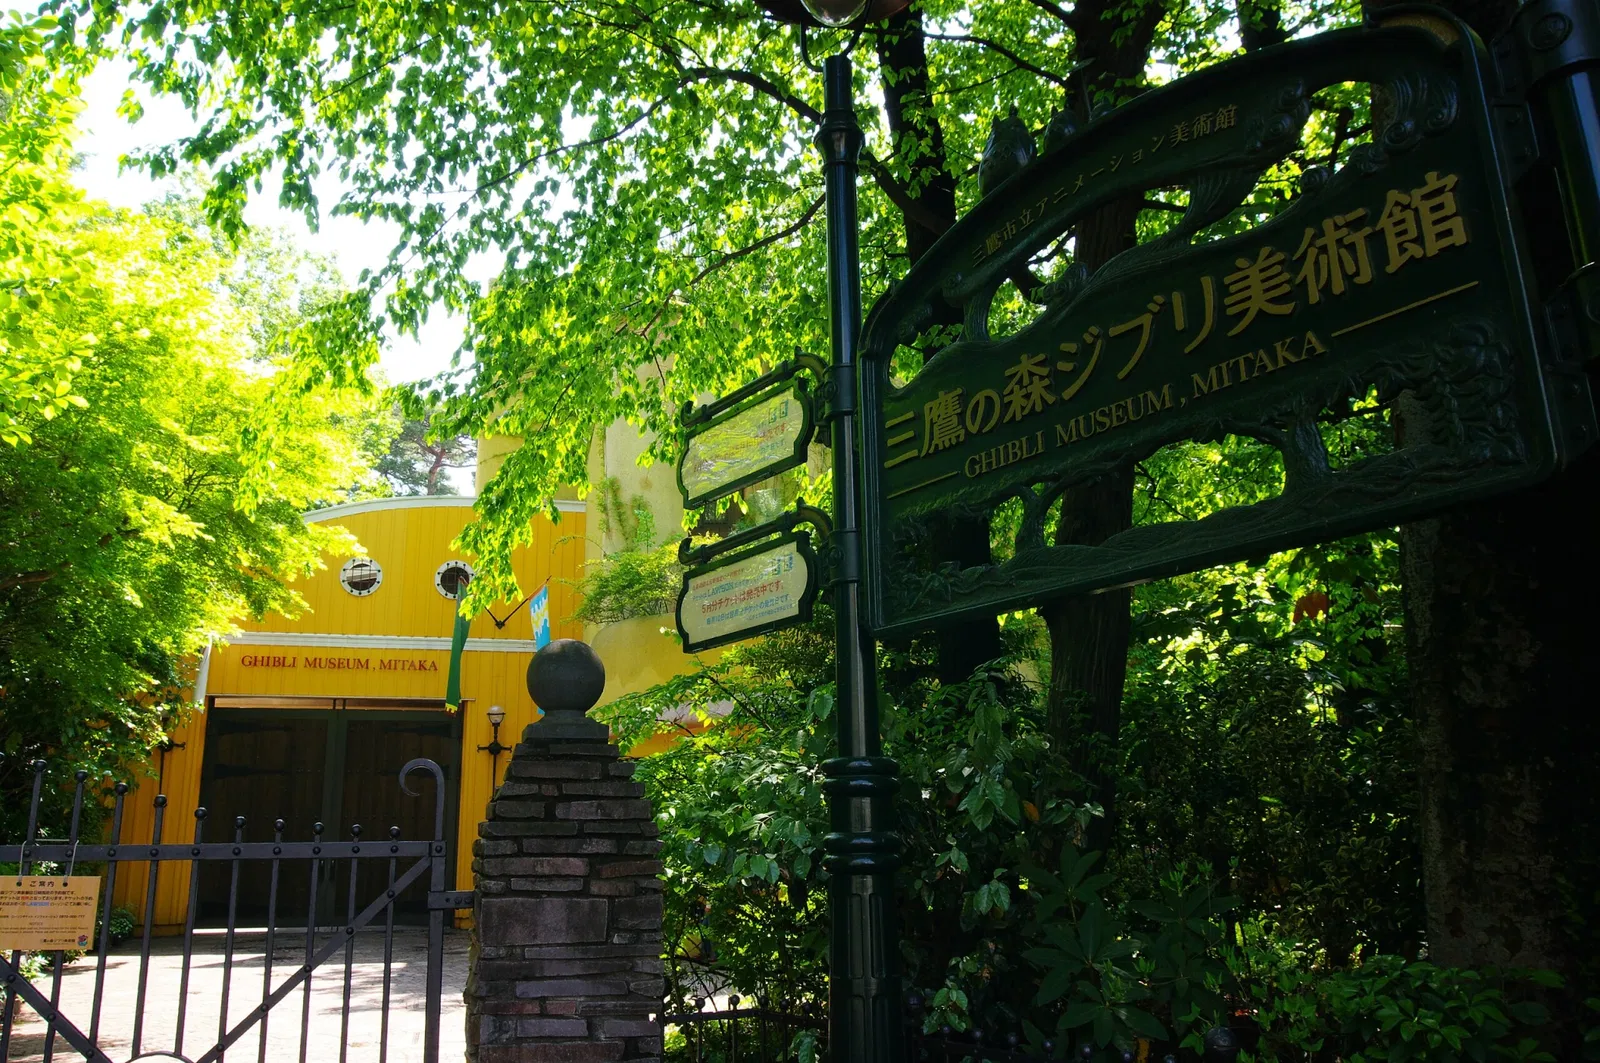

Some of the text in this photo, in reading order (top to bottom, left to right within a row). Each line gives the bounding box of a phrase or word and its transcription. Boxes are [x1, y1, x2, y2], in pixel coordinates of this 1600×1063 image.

[972, 104, 1238, 268] 三鷹市立アニメーション美術館
[884, 171, 1467, 468] 三鷹の森ジブリ美術館
[964, 430, 1046, 478] GHIBLI
[1191, 330, 1329, 399] MITAKA
[241, 655, 297, 668] GHIBLI
[379, 659, 438, 672] MITAKA
[29, 880, 55, 888] ご案内
